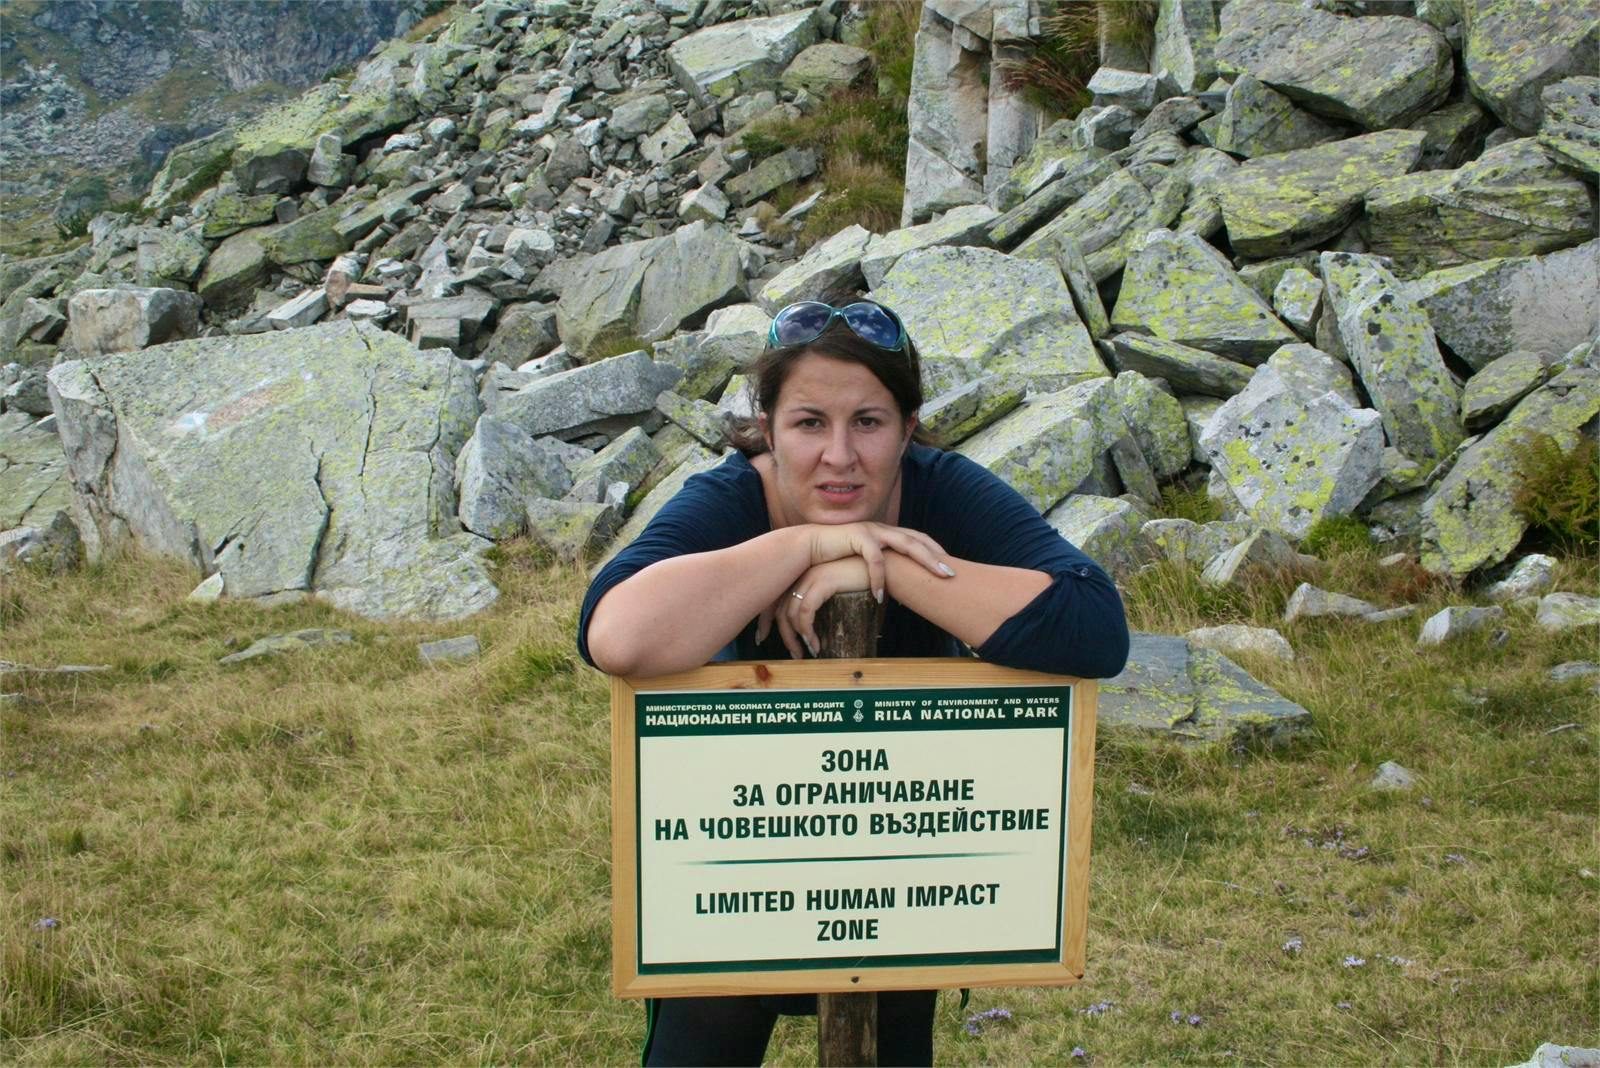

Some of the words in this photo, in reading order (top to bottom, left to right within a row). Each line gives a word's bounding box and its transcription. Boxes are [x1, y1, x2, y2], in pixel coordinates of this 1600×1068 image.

[645, 704, 713, 712] МИНИСТЕРСТВО
[715, 703, 727, 711] НА
[728, 703, 773, 711] ОКОЛНАТА
[774, 702, 802, 710] СРЕДА
[812, 701, 845, 710] ВОДИТЕ
[874, 700, 917, 708] MINISTRY
[921, 699, 933, 707] OF
[937, 698, 999, 706] ENVIRONMENT
[1026, 697, 1060, 705] WATERS
[645, 712, 752, 728] НАЦИОНАЛЕН
[756, 711, 798, 724] ПАРК
[801, 710, 844, 723] РИЛА
[874, 709, 913, 722] RILA
[920, 707, 1006, 720] NATIONAL
[1013, 706, 1058, 718] PARK
[822, 749, 889, 772] ЗОНА
[733, 784, 764, 806] ЗА
[776, 779, 974, 804] ОГРАНИЧАВАНЕ
[656, 819, 688, 840] НА
[700, 814, 857, 839] ЧОВЕШКОТО
[870, 807, 1049, 837] ВЪЗДЕЙСТВИЕ
[696, 891, 794, 914] LIMITED
[807, 888, 895, 910] HUMAN
[907, 884, 1000, 907] IMPACT
[817, 919, 878, 941] ZONE
